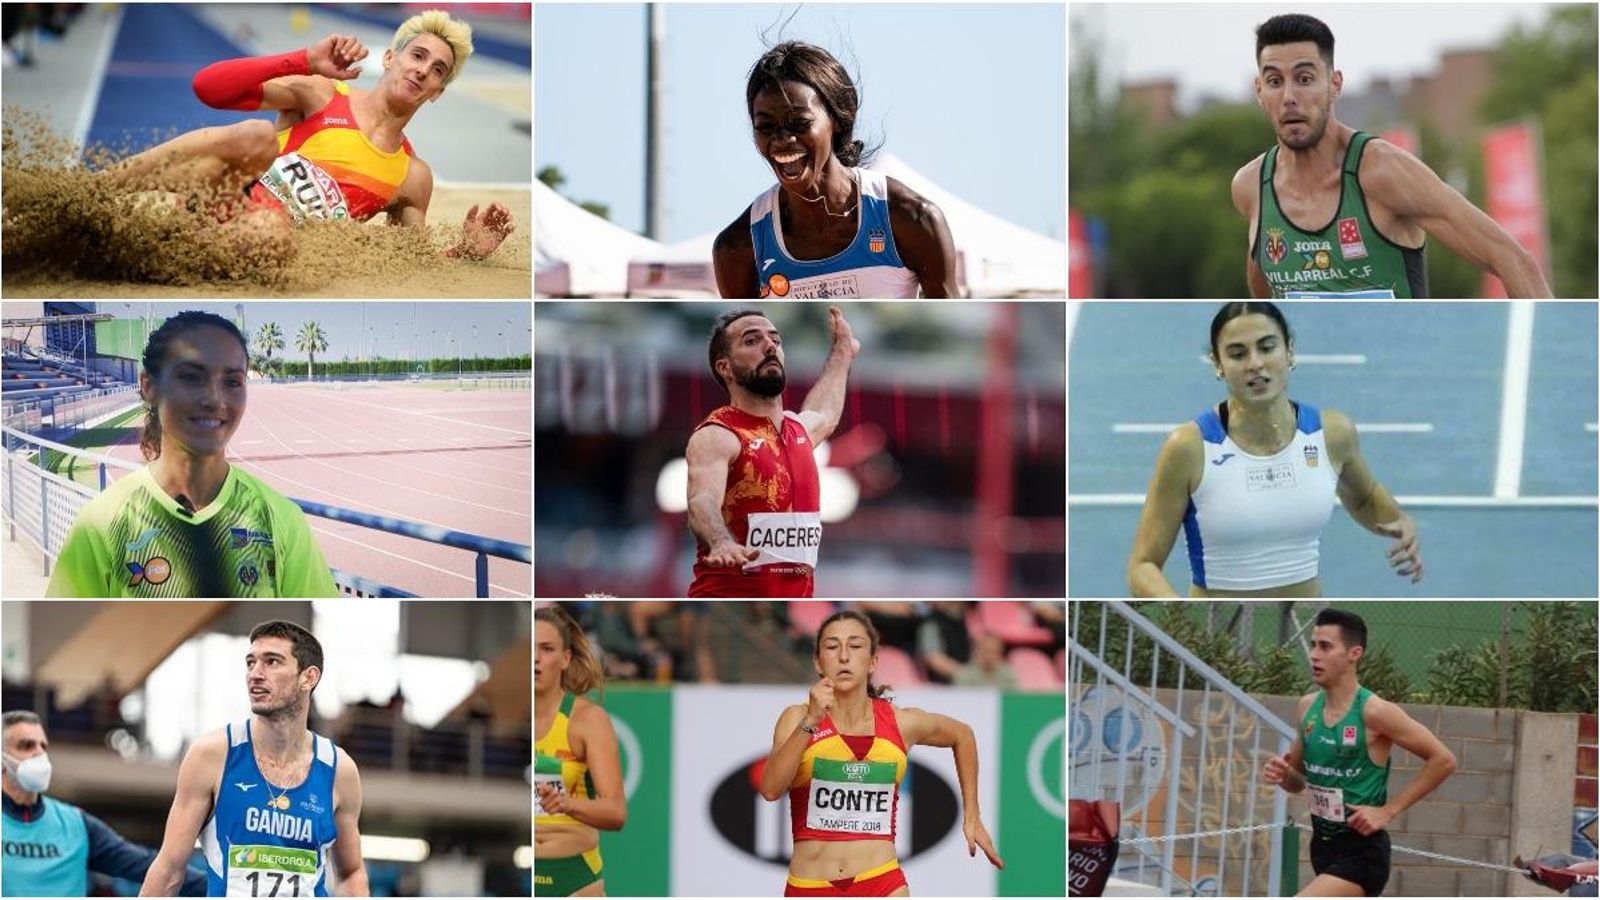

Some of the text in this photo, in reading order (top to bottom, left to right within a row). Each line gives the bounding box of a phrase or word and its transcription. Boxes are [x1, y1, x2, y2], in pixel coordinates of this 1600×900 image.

[1265, 268, 1348, 282] VILLARREAL
[750, 526, 821, 548] CACERES
[815, 787, 889, 812] CONTE
[245, 807, 312, 842] GANDIA
[2, 841, 62, 858] oma
[259, 854, 311, 867] IBERDROLA
[246, 871, 300, 897] 171
